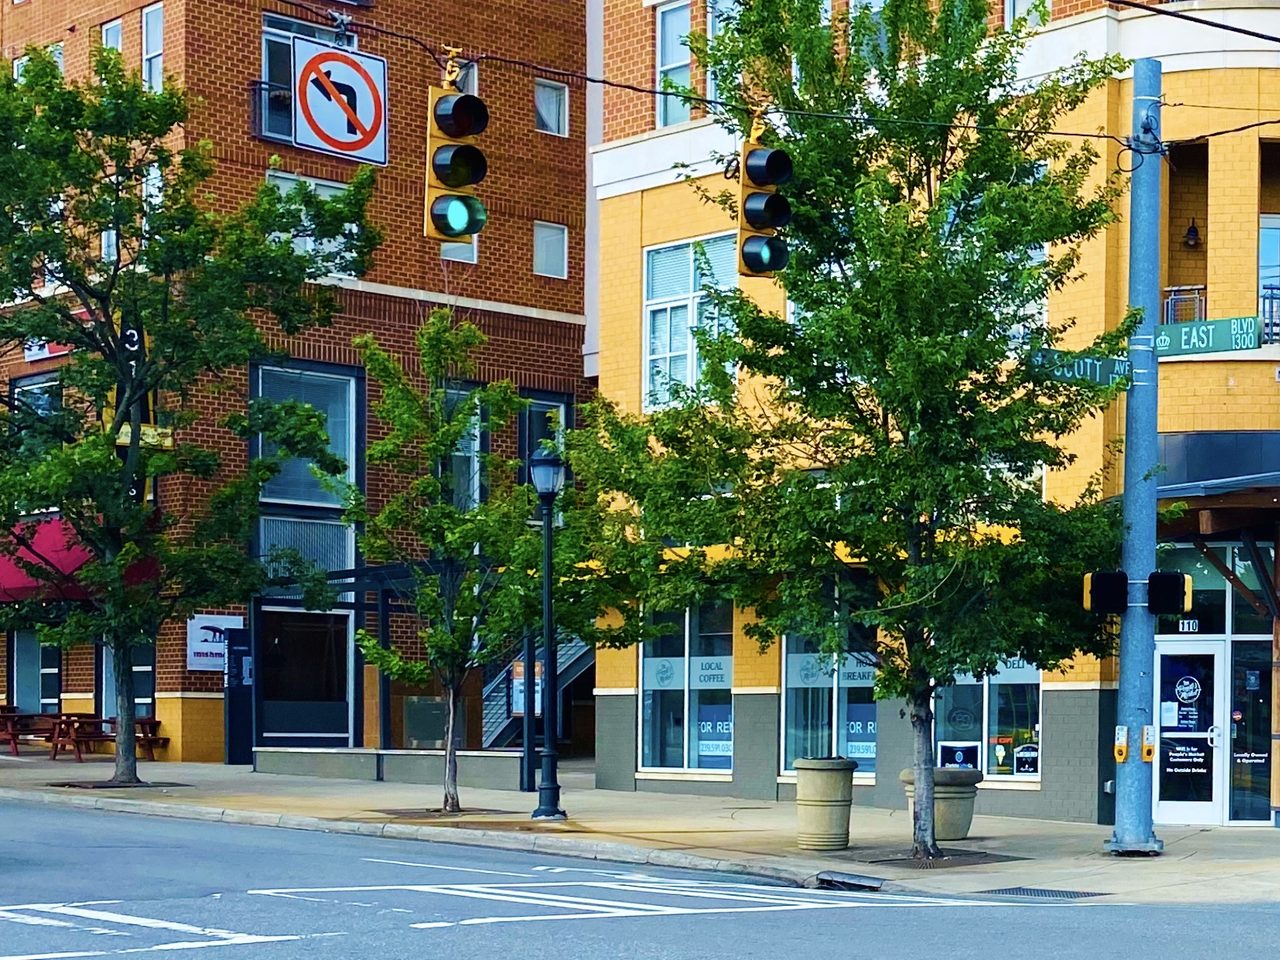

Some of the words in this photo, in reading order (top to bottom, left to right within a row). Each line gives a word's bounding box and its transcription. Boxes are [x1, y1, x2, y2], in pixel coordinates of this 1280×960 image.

[1231, 318, 1255, 334] BLVD
[1181, 325, 1215, 349] EAST
[1232, 333, 1254, 349] 1300
[1114, 360, 1131, 375] AVE
[1180, 620, 1198, 631] 110
[701, 662, 723, 671] LOCAL
[1005, 659, 1025, 670] DELI
[699, 674, 725, 683] COFFEE
